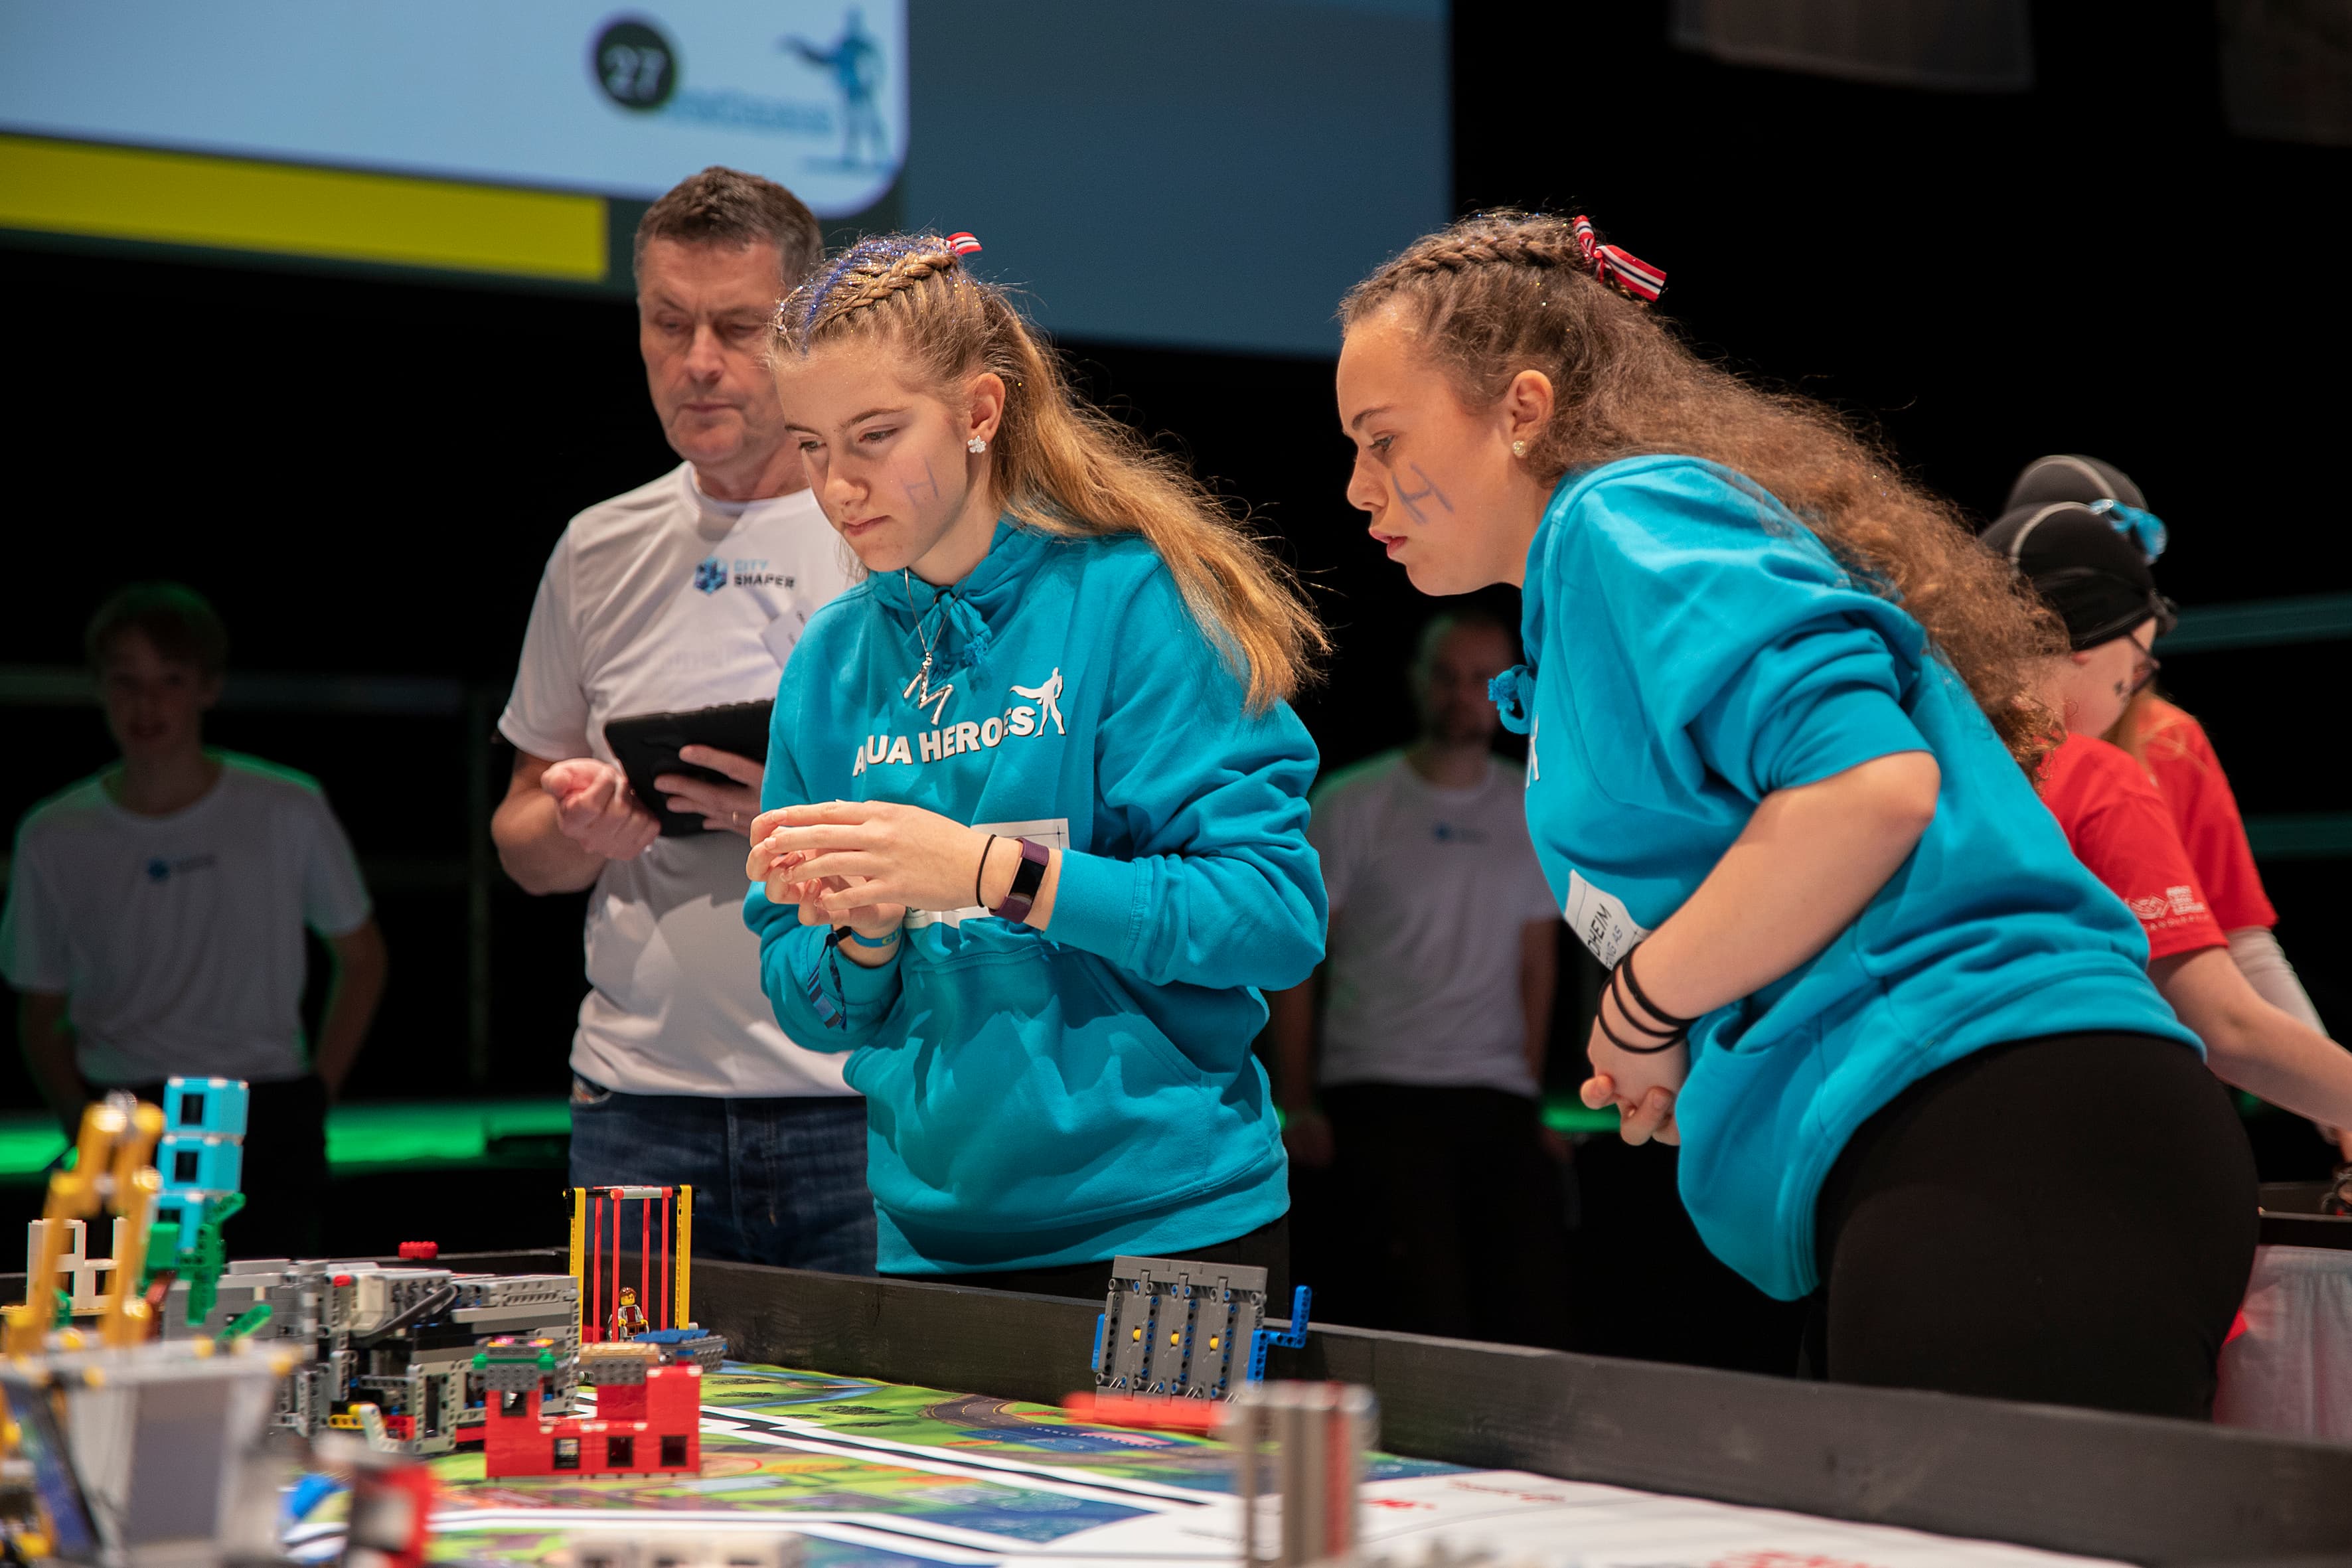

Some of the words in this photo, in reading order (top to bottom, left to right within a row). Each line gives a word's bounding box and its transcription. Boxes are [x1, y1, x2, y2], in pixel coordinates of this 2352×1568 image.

[734, 559, 769, 573] CITY
[734, 573, 795, 589] SHAPER
[852, 734, 913, 777] AUA
